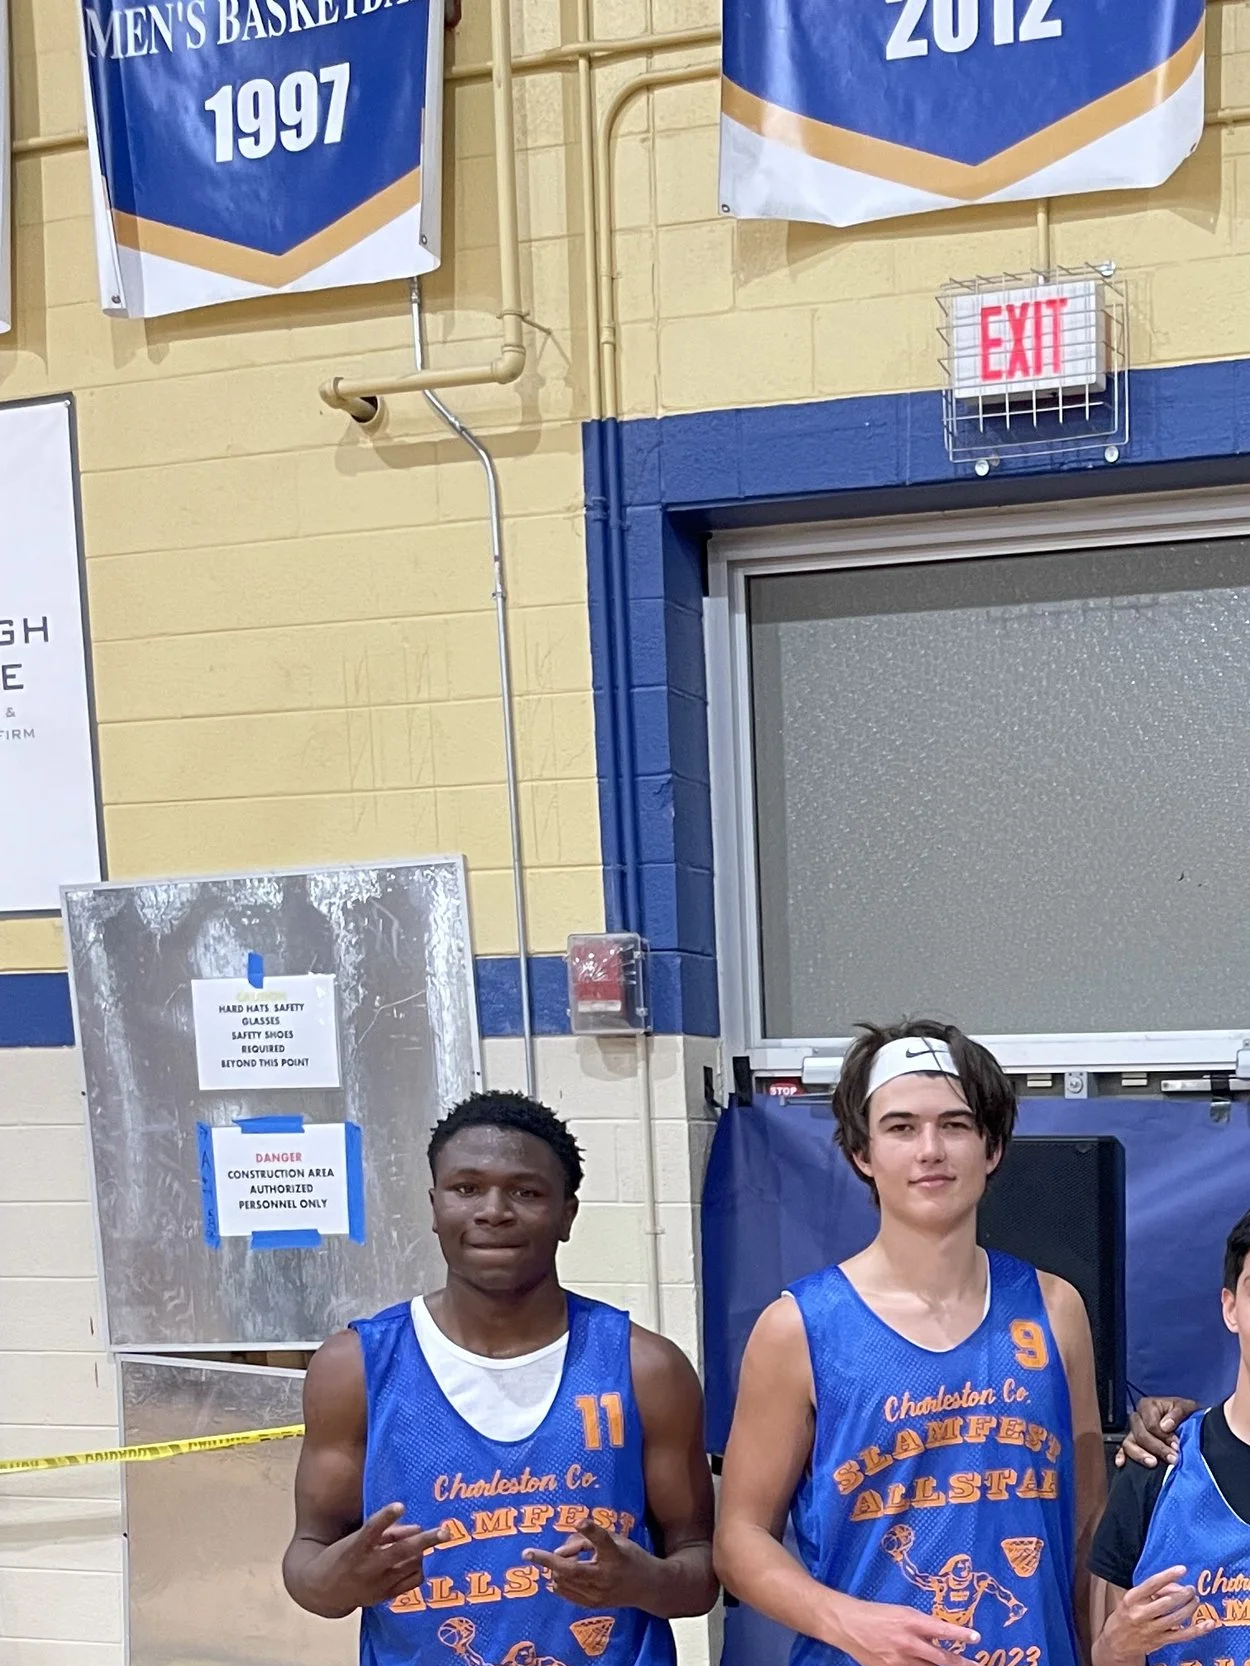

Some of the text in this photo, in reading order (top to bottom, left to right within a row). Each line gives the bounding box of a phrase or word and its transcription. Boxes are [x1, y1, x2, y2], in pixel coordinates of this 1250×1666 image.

[86, 0, 413, 60] MEN'S BASKET
[885, 0, 1062, 61] 2012
[204, 62, 352, 163] 1997
[981, 297, 1068, 381] EXIT
[218, 1003, 305, 1013] HARD HATS SAFETY
[241, 1016, 280, 1026] GLASSES
[231, 1030, 294, 1040] SAFETY SHOES
[241, 1044, 285, 1054] REQUIRED
[221, 1058, 309, 1068] BEYOND THIS POINT
[769, 1086, 798, 1096] STOP
[255, 1152, 302, 1163] DANGER
[227, 1168, 335, 1180] CONSTRUCTION AREA
[250, 1184, 314, 1194] AUTHORIZED
[239, 1198, 328, 1210] PERSONNEL ONLY
[1009, 1318, 1051, 1371] 9
[883, 1377, 1032, 1422] Charleston Co.
[576, 1393, 627, 1450] 11
[833, 1415, 1061, 1496] SLAMFEST
[433, 1463, 600, 1502] Charleston Co.
[423, 1504, 636, 1557] AMFEST
